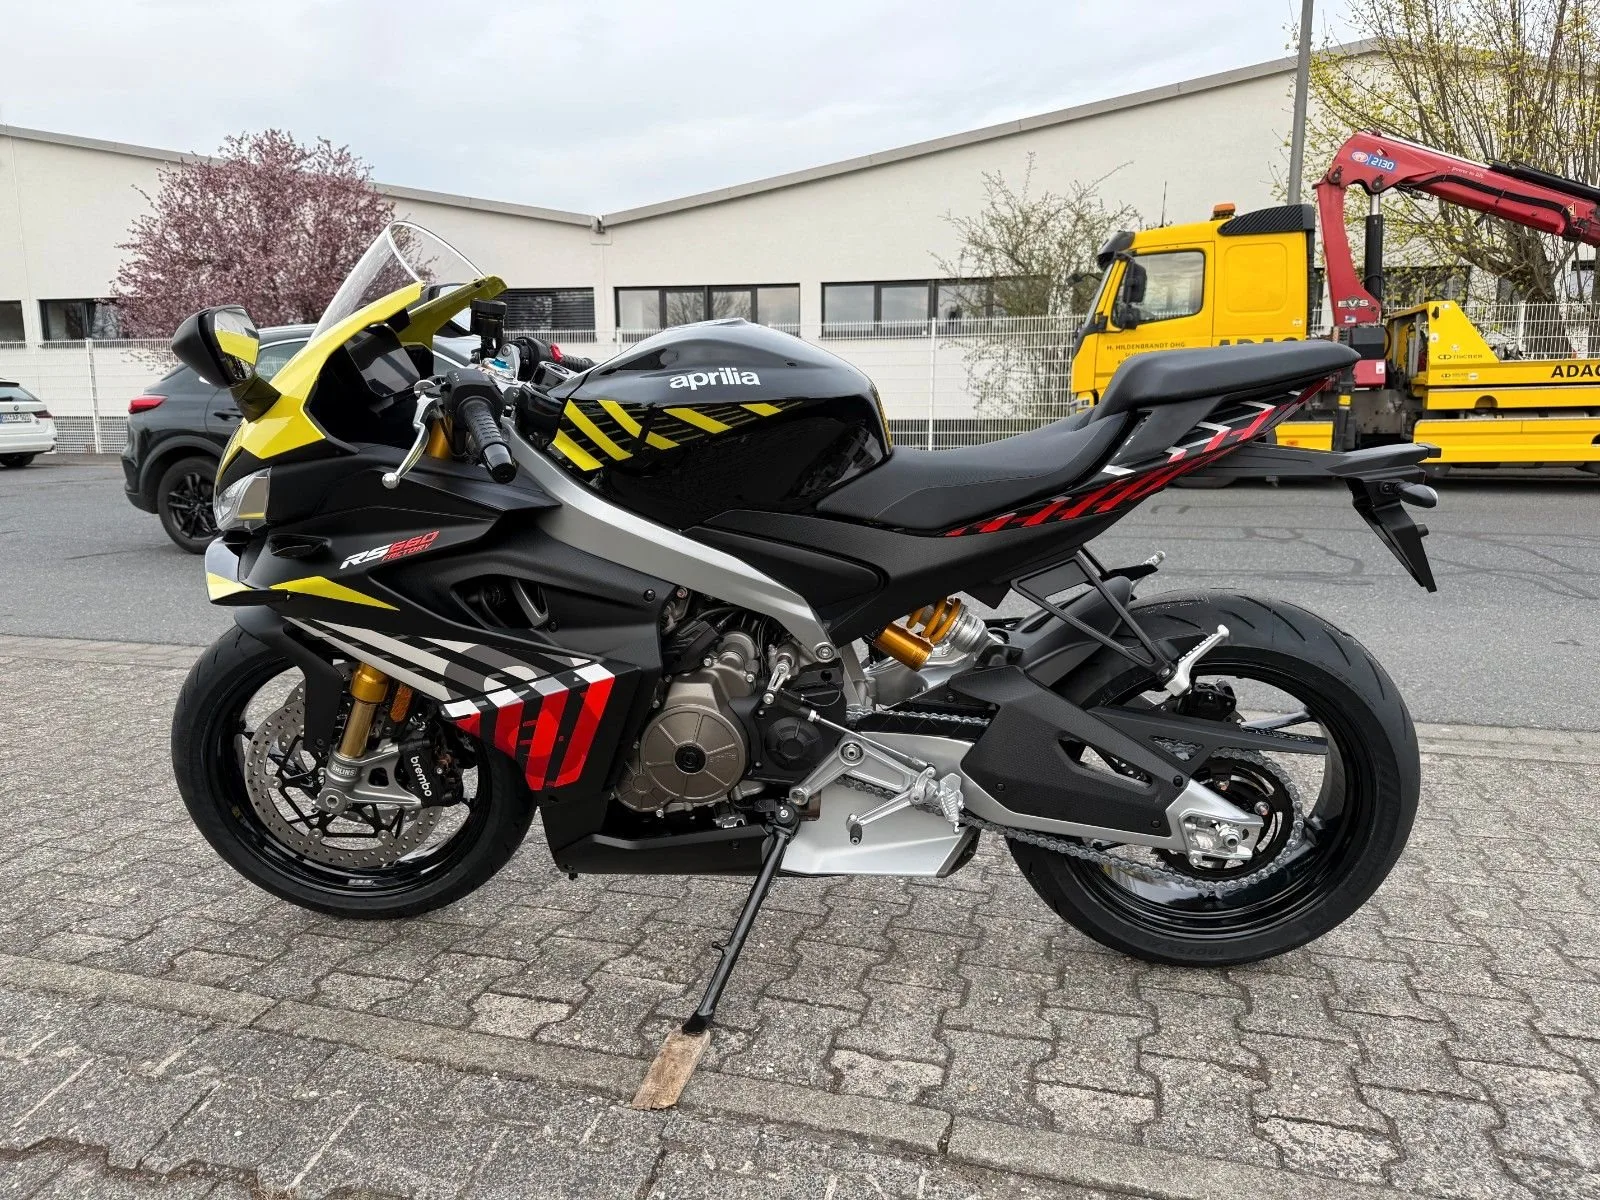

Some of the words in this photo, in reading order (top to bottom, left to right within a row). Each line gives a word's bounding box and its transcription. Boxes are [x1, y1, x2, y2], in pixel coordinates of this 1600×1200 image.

[1370, 157, 1394, 170] 2130
[1337, 299, 1369, 308] EVS
[1115, 343, 1168, 351] HILDENBRANDT
[669, 367, 761, 390] aprilia
[381, 541, 433, 562] FACTORY
[410, 755, 432, 797] brembo
